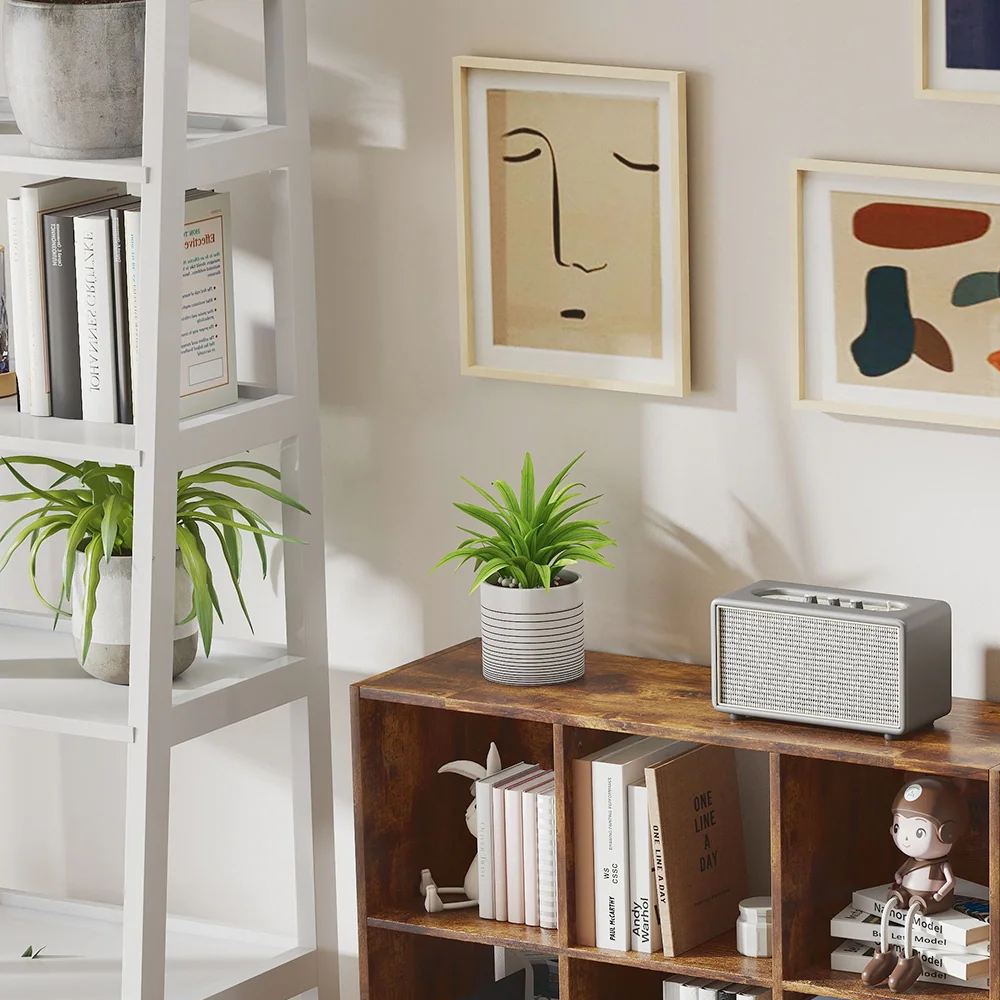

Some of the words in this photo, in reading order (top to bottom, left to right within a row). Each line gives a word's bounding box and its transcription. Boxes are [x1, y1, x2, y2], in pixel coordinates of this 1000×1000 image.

[694, 790, 712, 812] ONE
[694, 810, 716, 833] LINE
[704, 834, 710, 850] A
[700, 850, 718, 872] DAY
[604, 868, 609, 879] WS
[632, 902, 642, 937] Andy
[640, 898, 649, 943] Warhol
[914, 917, 942, 934] Model
[915, 936, 946, 945] Model
[919, 951, 943, 967] odel
